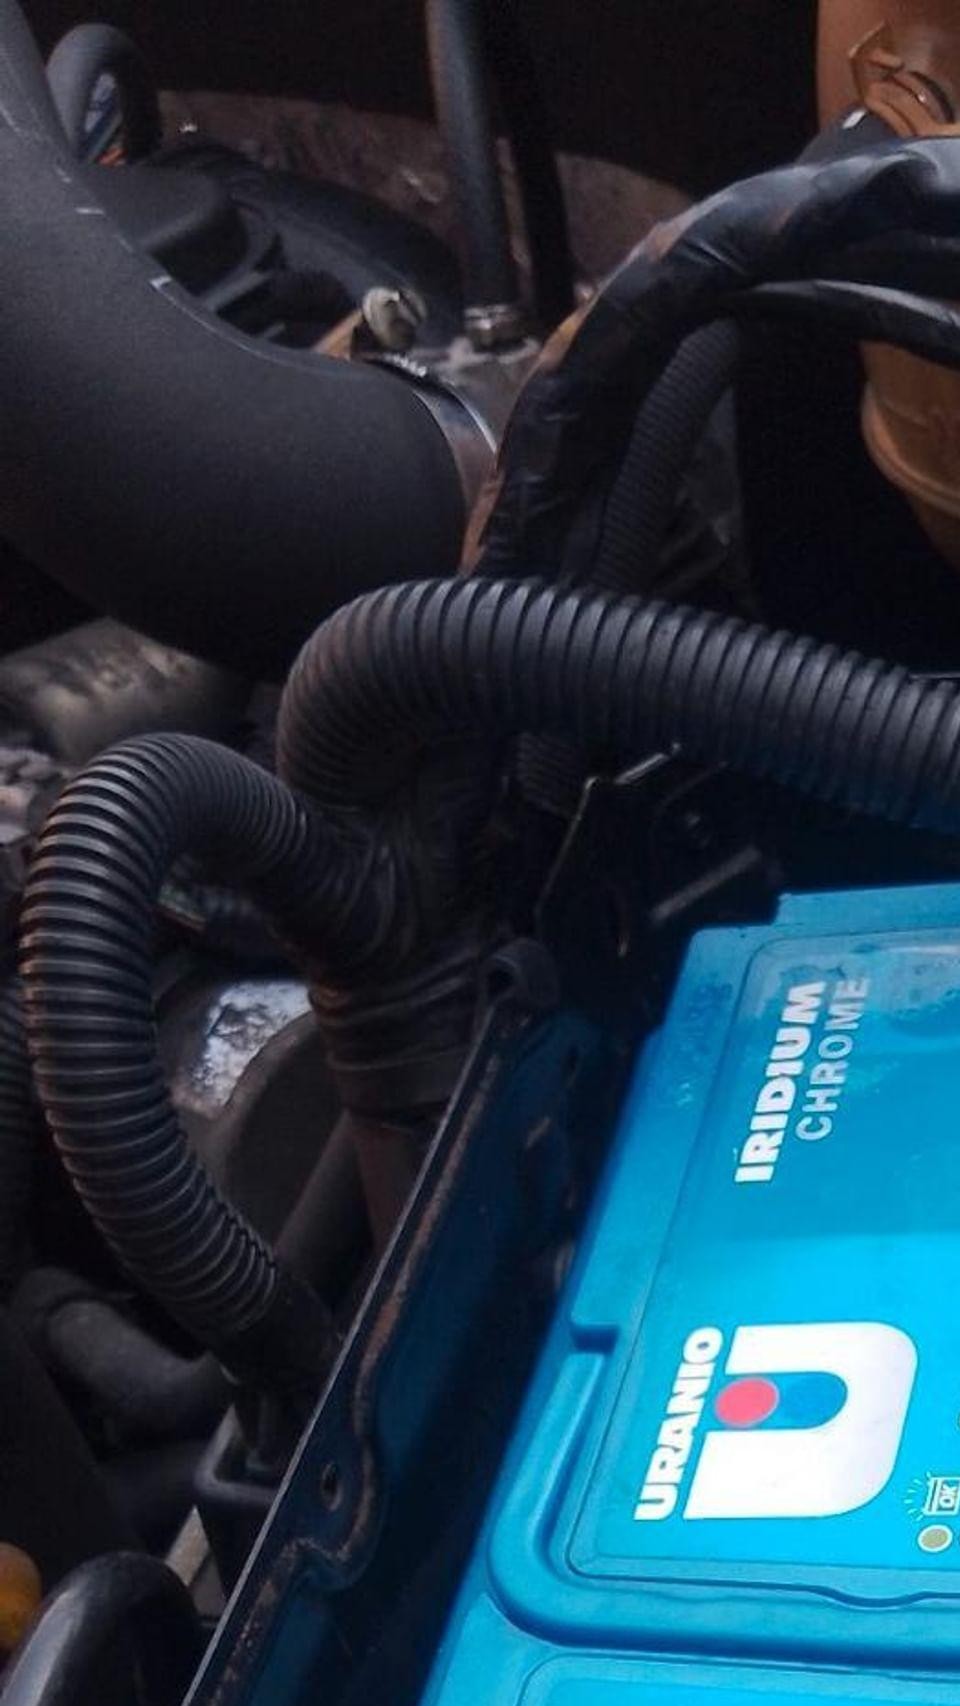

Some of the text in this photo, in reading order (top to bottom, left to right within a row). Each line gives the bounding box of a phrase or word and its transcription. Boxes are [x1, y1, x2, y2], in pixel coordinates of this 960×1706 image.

[735, 980, 827, 1183] IRIDIUM
[795, 977, 870, 1141] CHROME
[633, 1326, 723, 1520] URANIO
